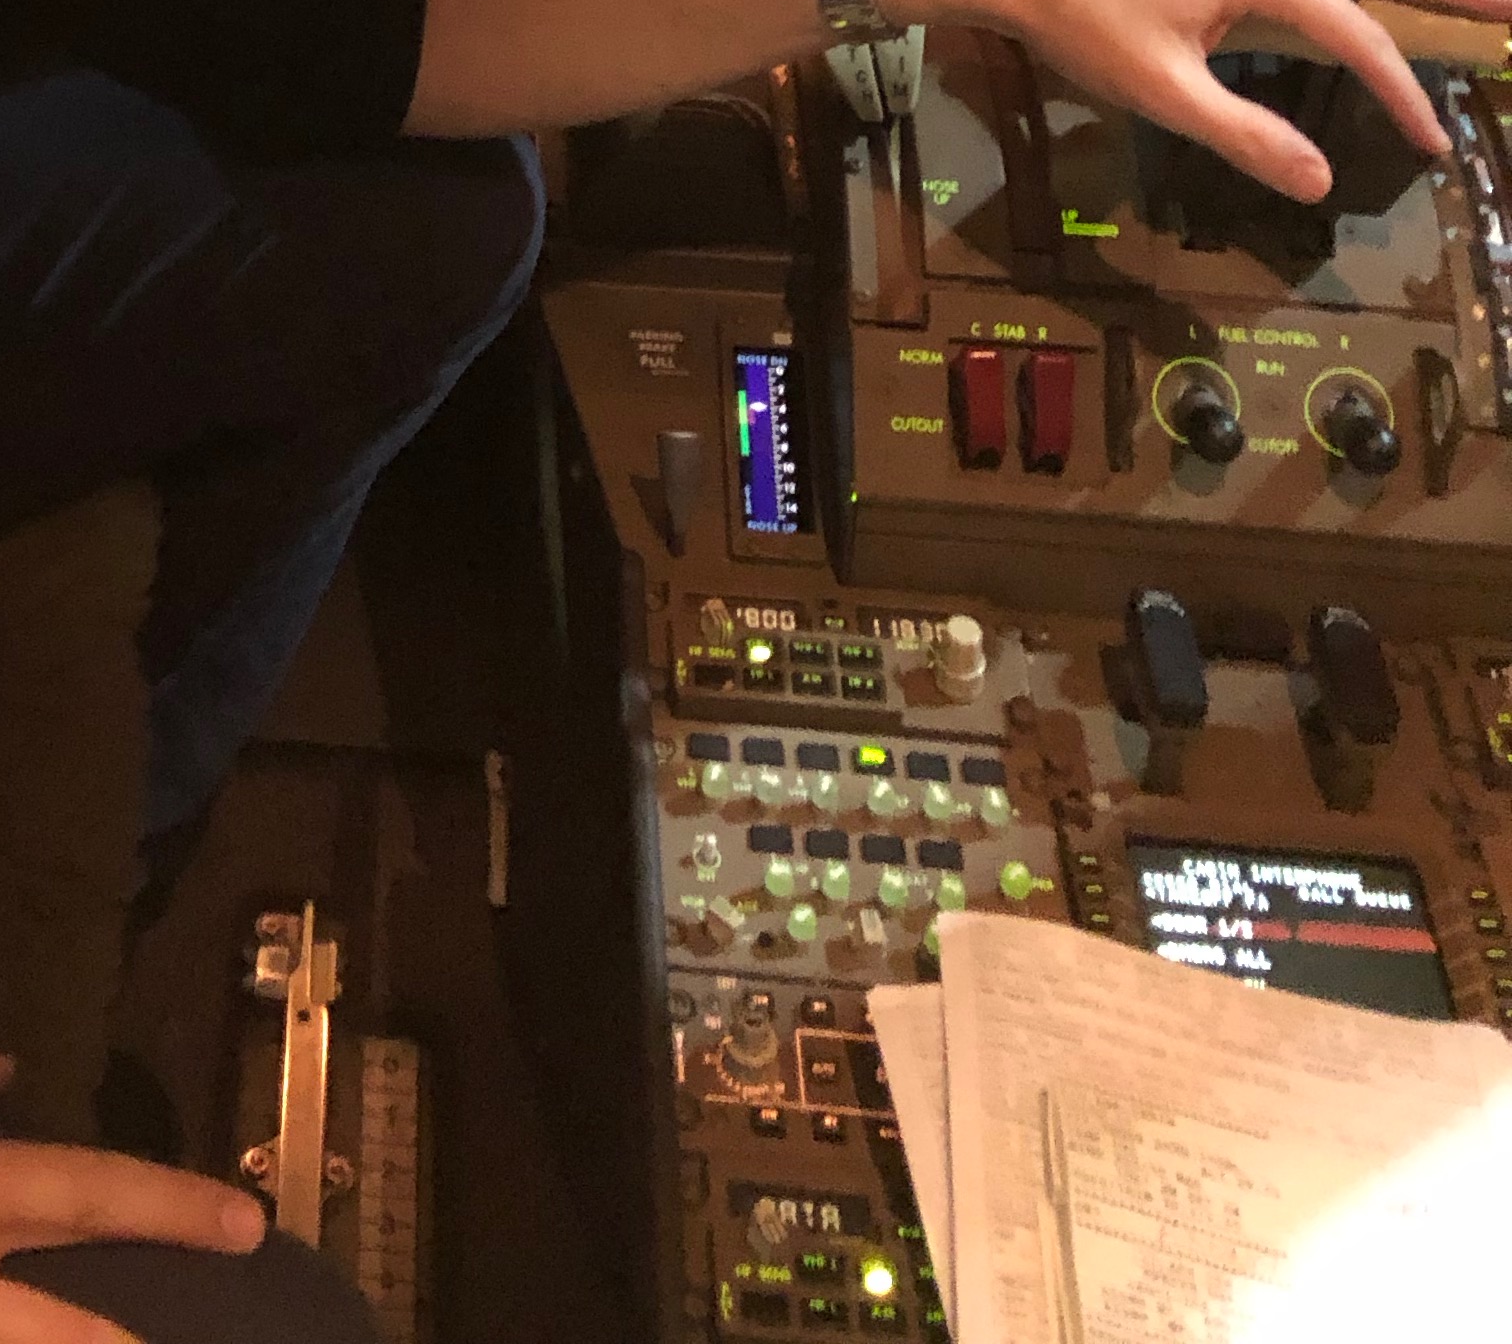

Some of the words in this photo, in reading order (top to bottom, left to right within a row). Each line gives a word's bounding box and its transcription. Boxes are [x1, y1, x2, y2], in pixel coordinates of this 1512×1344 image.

[924, 180, 958, 193] NOSE
[934, 194, 951, 205] UP
[1061, 209, 1077, 222] UP
[971, 323, 981, 336] C
[995, 324, 1026, 339] STAB
[1039, 327, 1047, 341] R
[1219, 326, 1249, 344] FUEL
[1254, 328, 1321, 348] CONTROL
[640, 355, 674, 368] PULL
[737, 354, 767, 364] NOSE
[900, 350, 943, 364] NORM
[1256, 360, 1285, 376] RUN
[891, 418, 944, 433] CUTOUT
[783, 462, 795, 472] 10
[786, 502, 798, 513] 14
[748, 520, 779, 530] NOSE
[782, 522, 798, 532] UP
